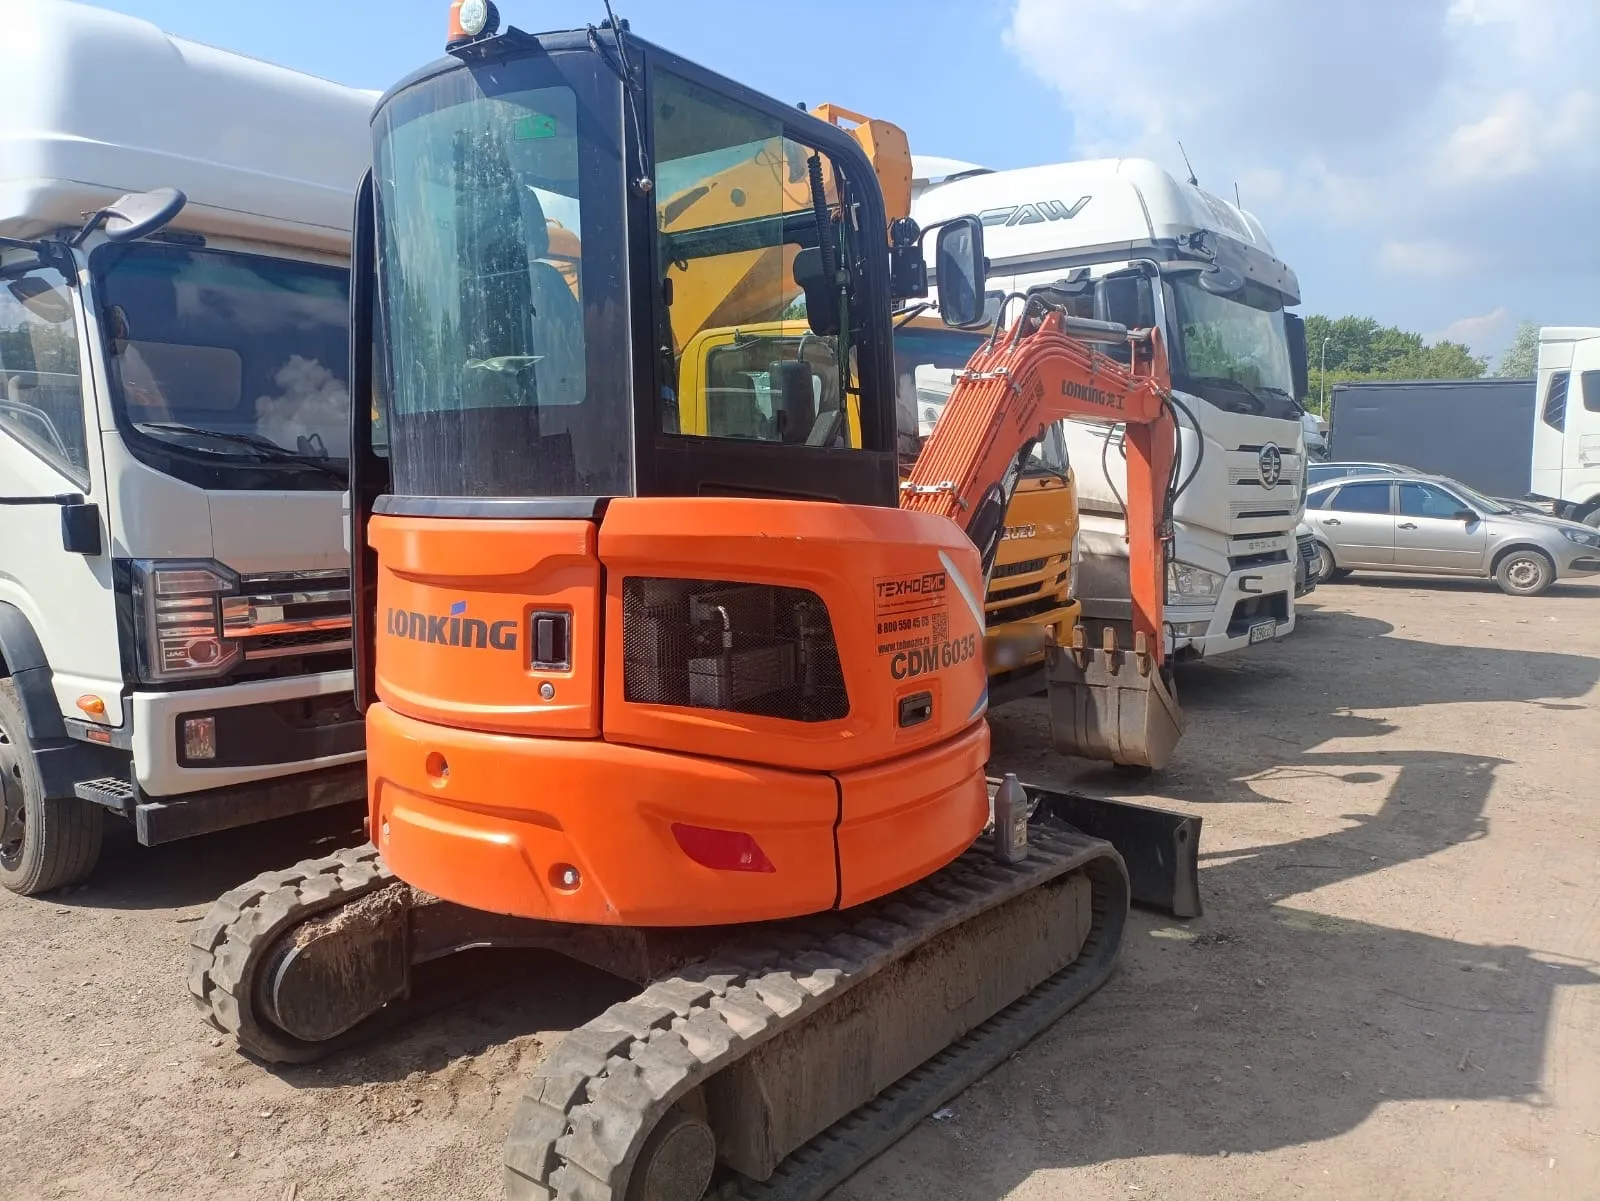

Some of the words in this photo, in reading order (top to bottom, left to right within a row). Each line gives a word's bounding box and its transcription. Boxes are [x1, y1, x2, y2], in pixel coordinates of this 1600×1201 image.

[979, 195, 1092, 227] FAW
[1062, 378, 1105, 406] LONKING
[1001, 523, 1036, 541] SUZU
[387, 600, 518, 651] LONKING
[877, 623, 883, 634] 8
[883, 621, 897, 633] 800
[898, 618, 912, 631] 550
[166, 650, 185, 658] JAC
[890, 646, 939, 680] CDM
[941, 633, 975, 668] 6035
